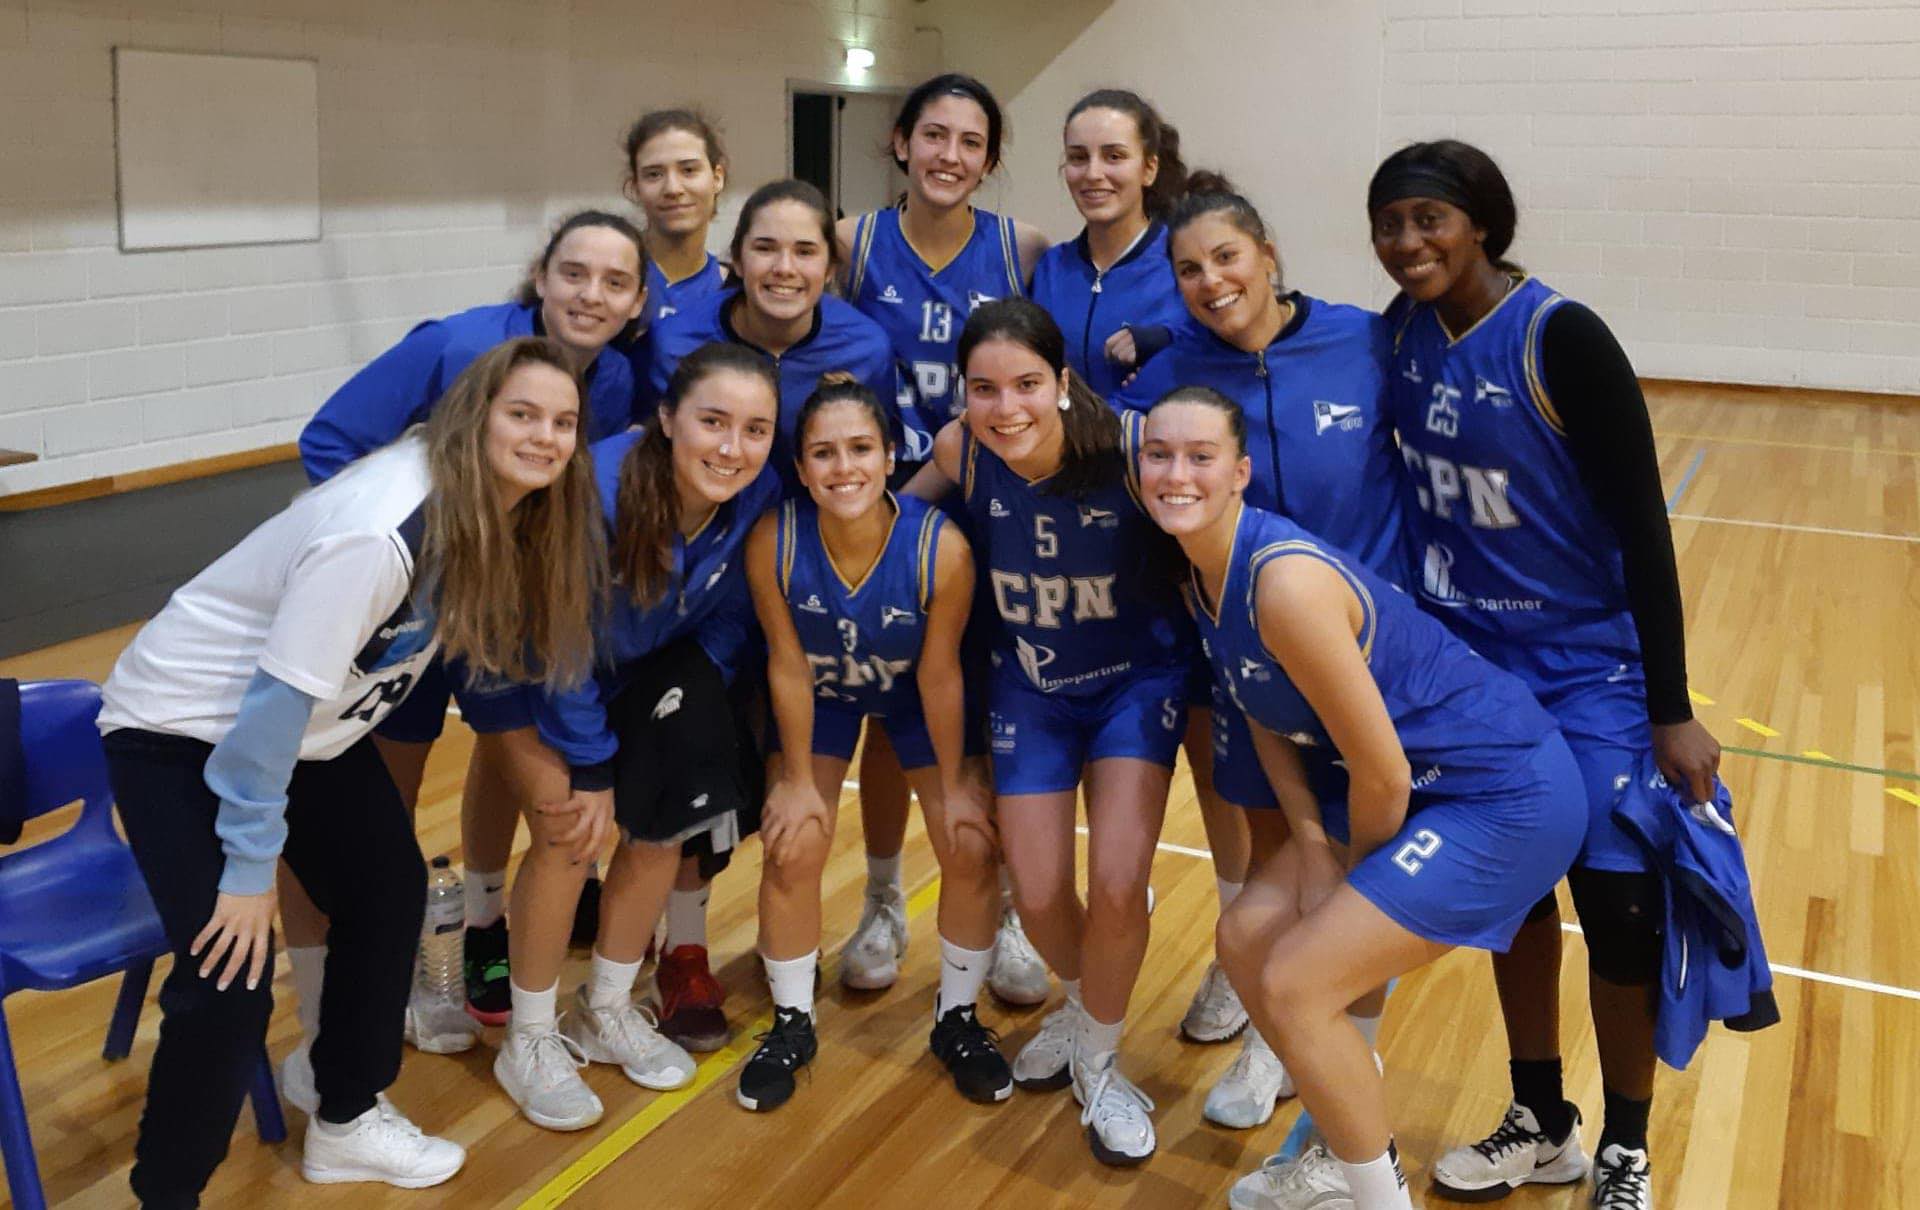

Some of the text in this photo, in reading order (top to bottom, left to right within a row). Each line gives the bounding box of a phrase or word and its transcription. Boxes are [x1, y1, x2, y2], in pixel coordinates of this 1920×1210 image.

[919, 300, 953, 343] 13
[1426, 381, 1462, 438] 25
[1035, 513, 1059, 559] 5
[990, 568, 1118, 630] CPN
[836, 617, 858, 653] 3
[1391, 827, 1443, 877] 2
